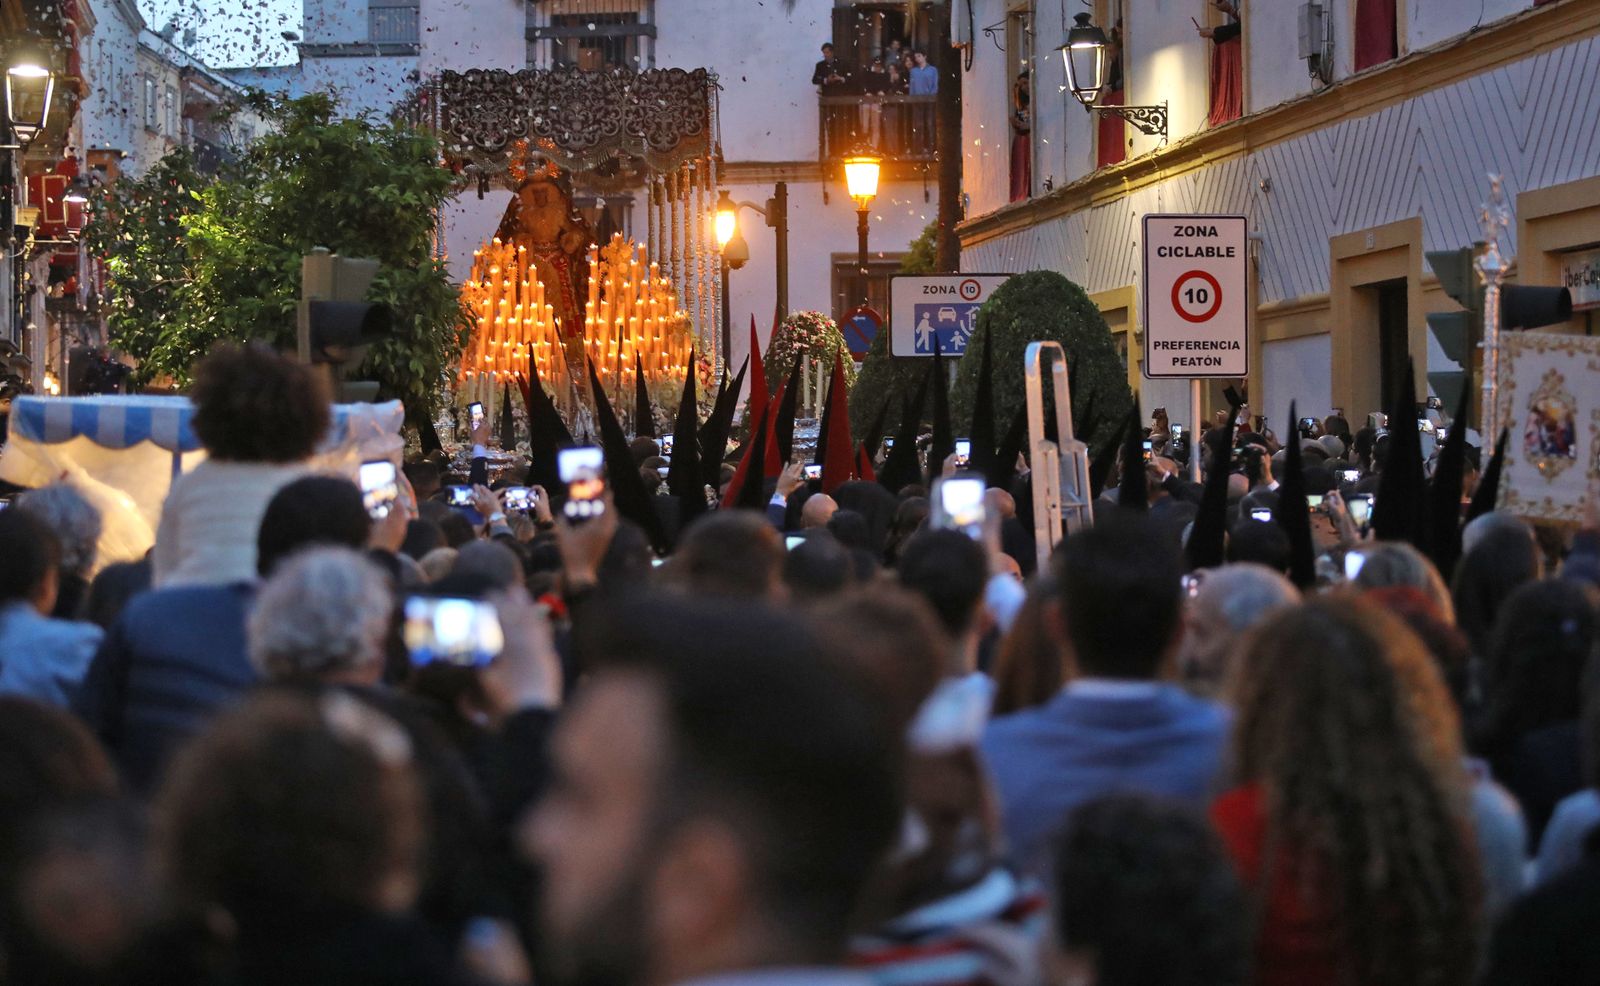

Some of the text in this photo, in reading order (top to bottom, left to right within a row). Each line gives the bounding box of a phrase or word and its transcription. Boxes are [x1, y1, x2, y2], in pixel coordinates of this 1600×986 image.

[1173, 226, 1219, 237] ZONA
[1157, 246, 1236, 258] CICLABLE
[923, 285, 976, 294] ZONA 10
[1184, 288, 1209, 304] 10
[1153, 341, 1240, 350] PREFERENCIA
[1172, 355, 1222, 366] PEATÓN
